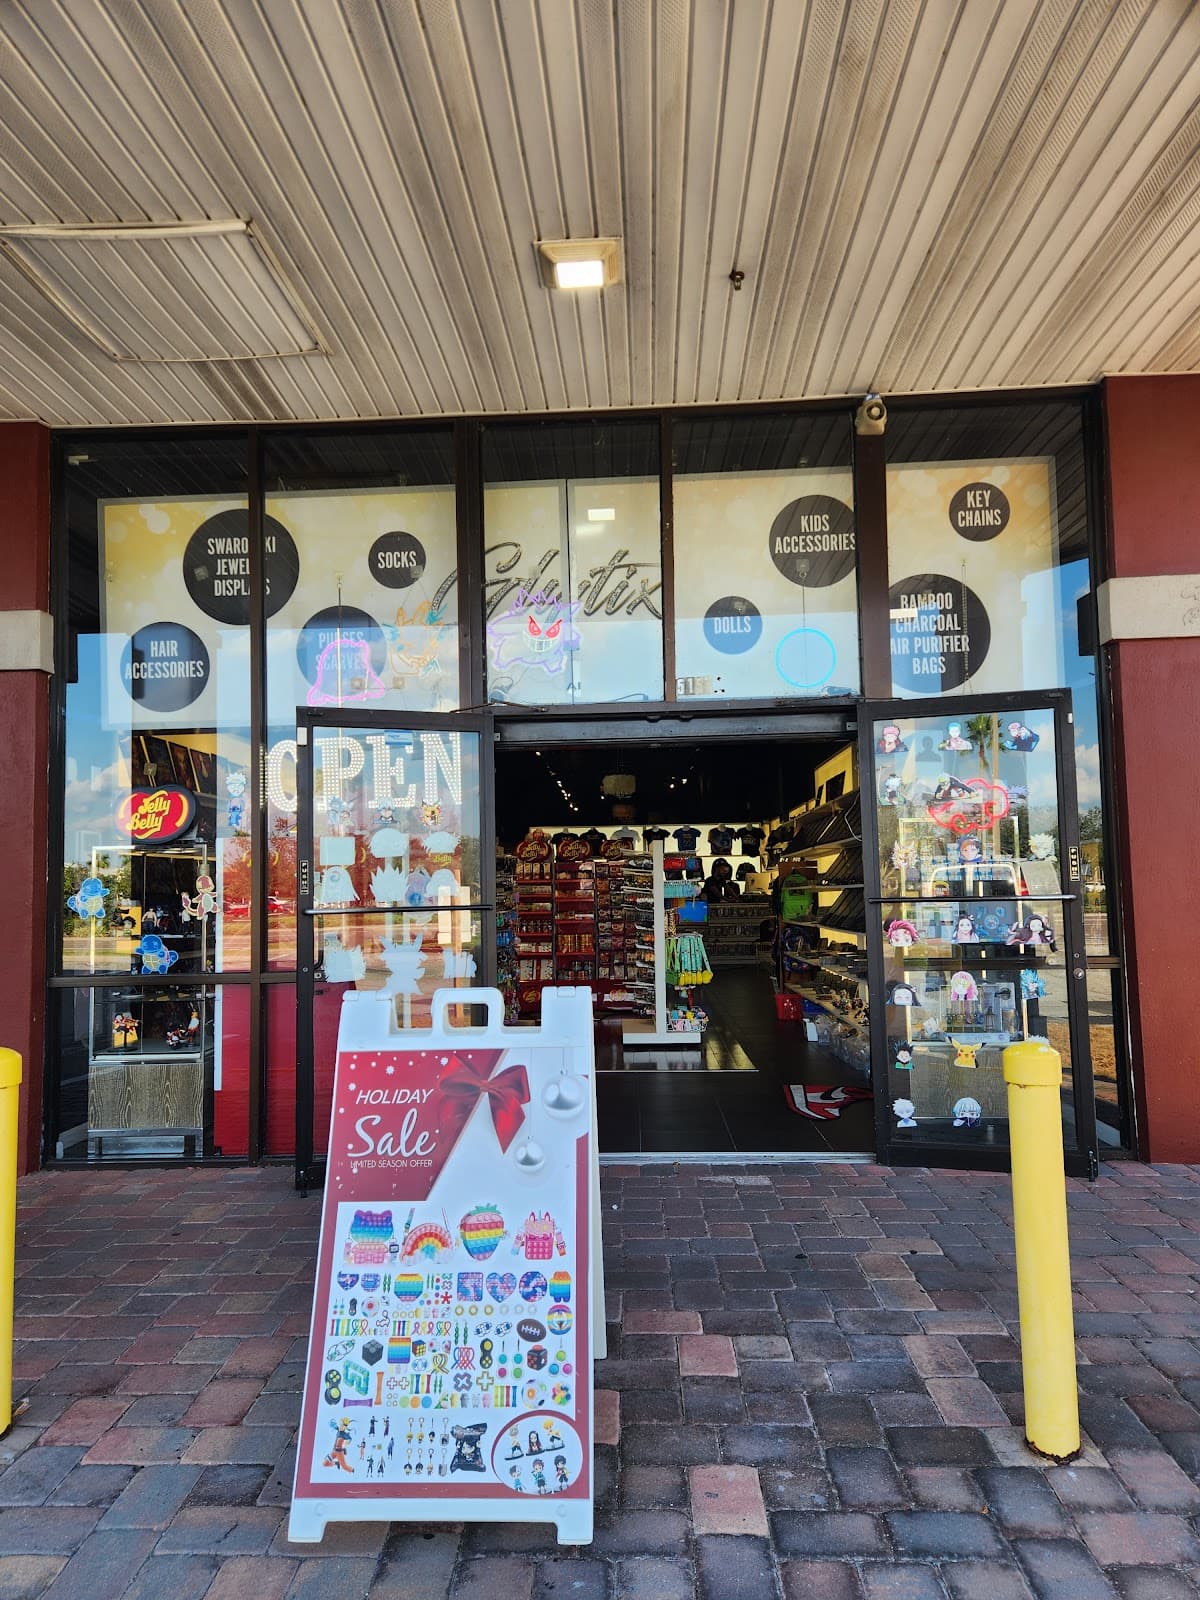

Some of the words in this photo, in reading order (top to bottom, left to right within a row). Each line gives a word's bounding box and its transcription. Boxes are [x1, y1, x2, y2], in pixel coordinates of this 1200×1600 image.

[966, 489, 990, 508] KEY
[800, 514, 830, 532] KIDS
[957, 508, 1001, 527] CHAINS
[207, 536, 276, 555] SWAROKI
[775, 532, 856, 554] ACCESSORIES
[377, 550, 417, 569] SOCKS
[900, 592, 953, 611] BAMBOO
[714, 615, 752, 634] DOLLS
[895, 613, 961, 633] CHARCOAL
[150, 639, 178, 658] HAIR
[891, 637, 910, 655] AIR
[914, 633, 970, 654] PURIFIER
[124, 660, 204, 680] ACCESSORIES
[912, 656, 947, 674] BAGS
[259, 731, 463, 812] OPEN
[138, 790, 171, 816] Jelly
[126, 812, 163, 839] Belly
[355, 1088, 434, 1105] HOLIDAY
[346, 1107, 437, 1157] Sale
[350, 1159, 377, 1169] LIMITED
[378, 1159, 408, 1168] SEASON
[409, 1159, 433, 1168] OFFER
